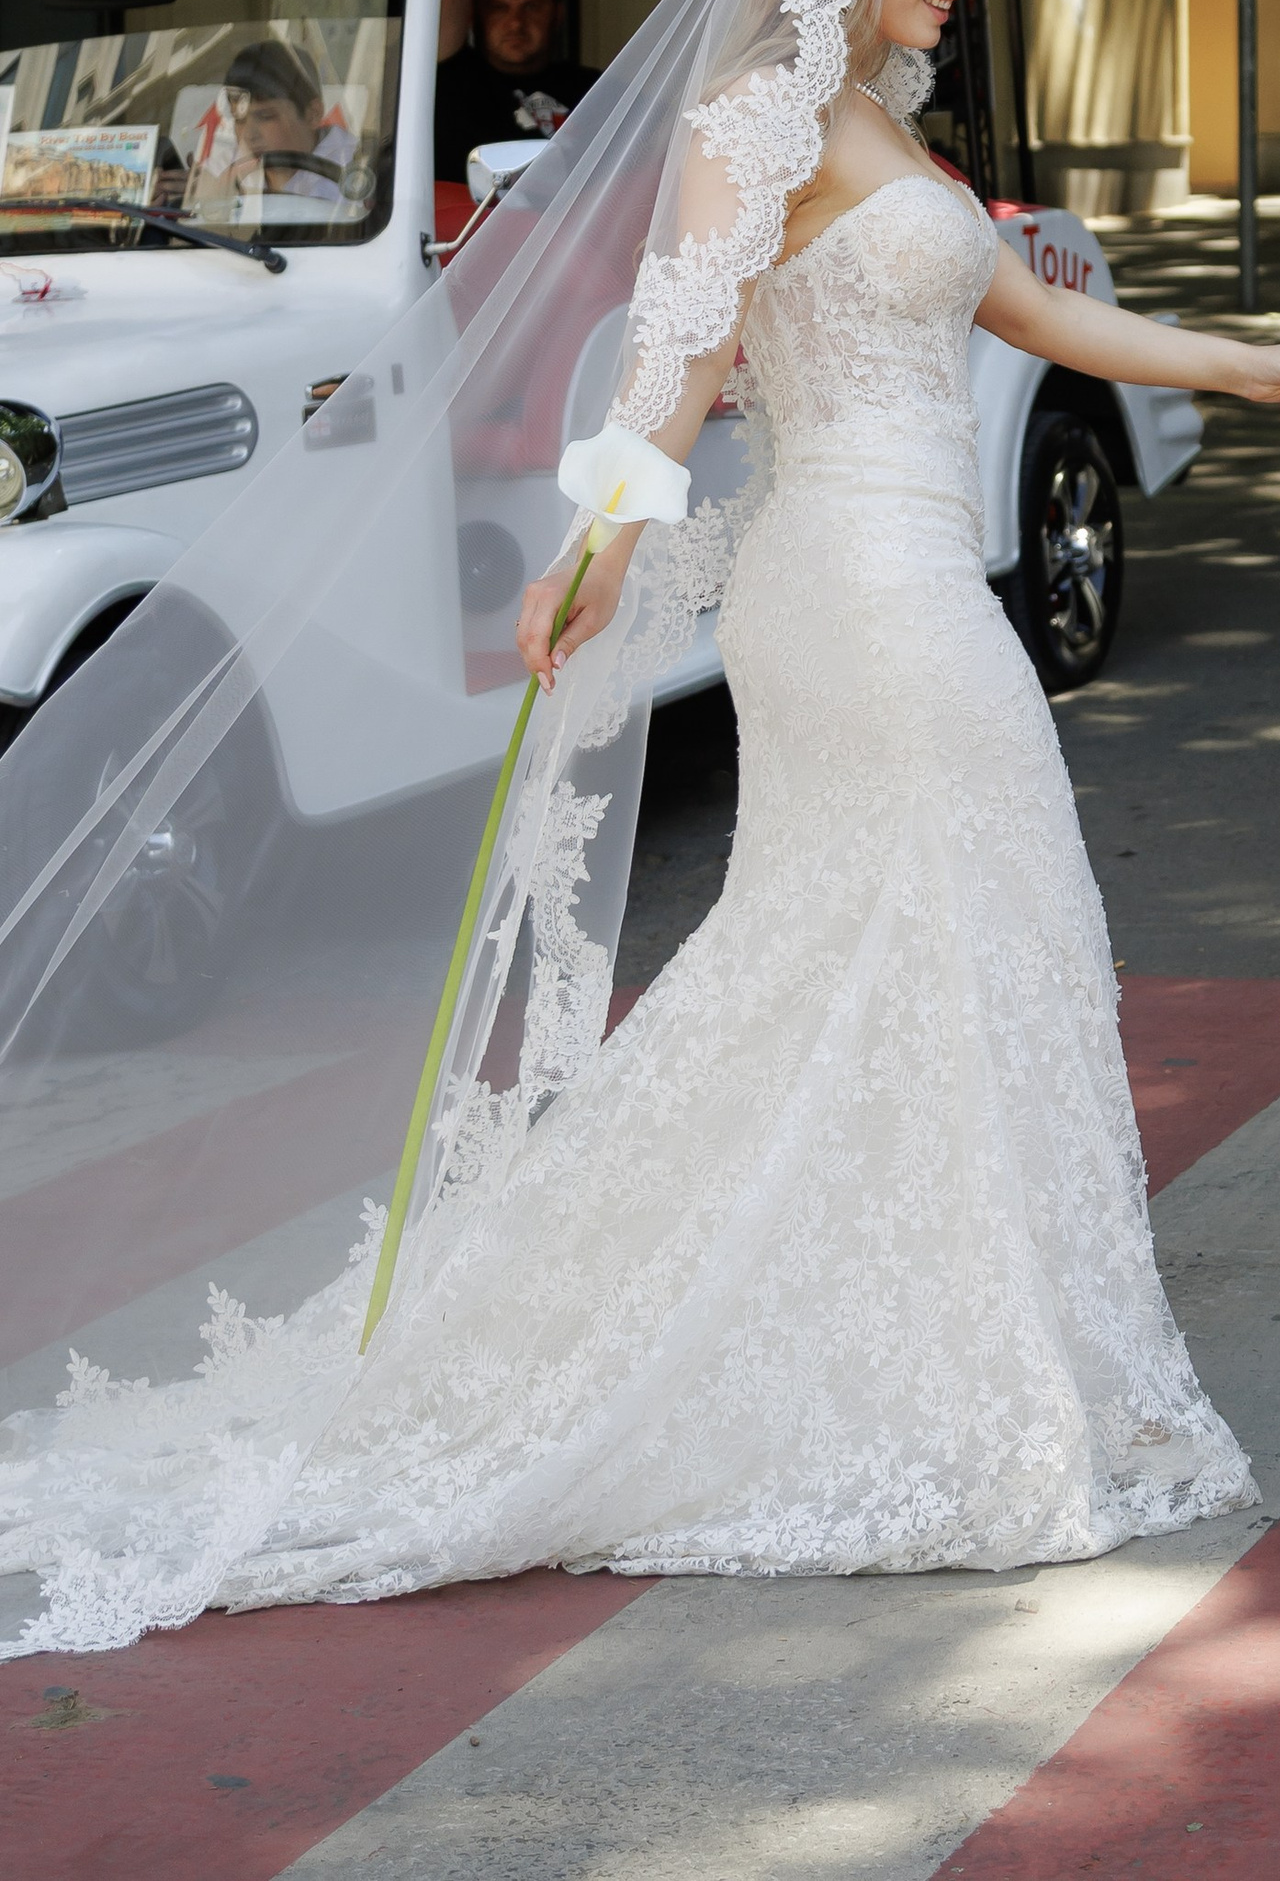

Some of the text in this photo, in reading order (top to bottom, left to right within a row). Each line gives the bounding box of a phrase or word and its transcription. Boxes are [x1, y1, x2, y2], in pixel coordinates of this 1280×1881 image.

[100, 132, 116, 143] By
[118, 131, 149, 142] Boat
[1021, 223, 1094, 295] Tour
